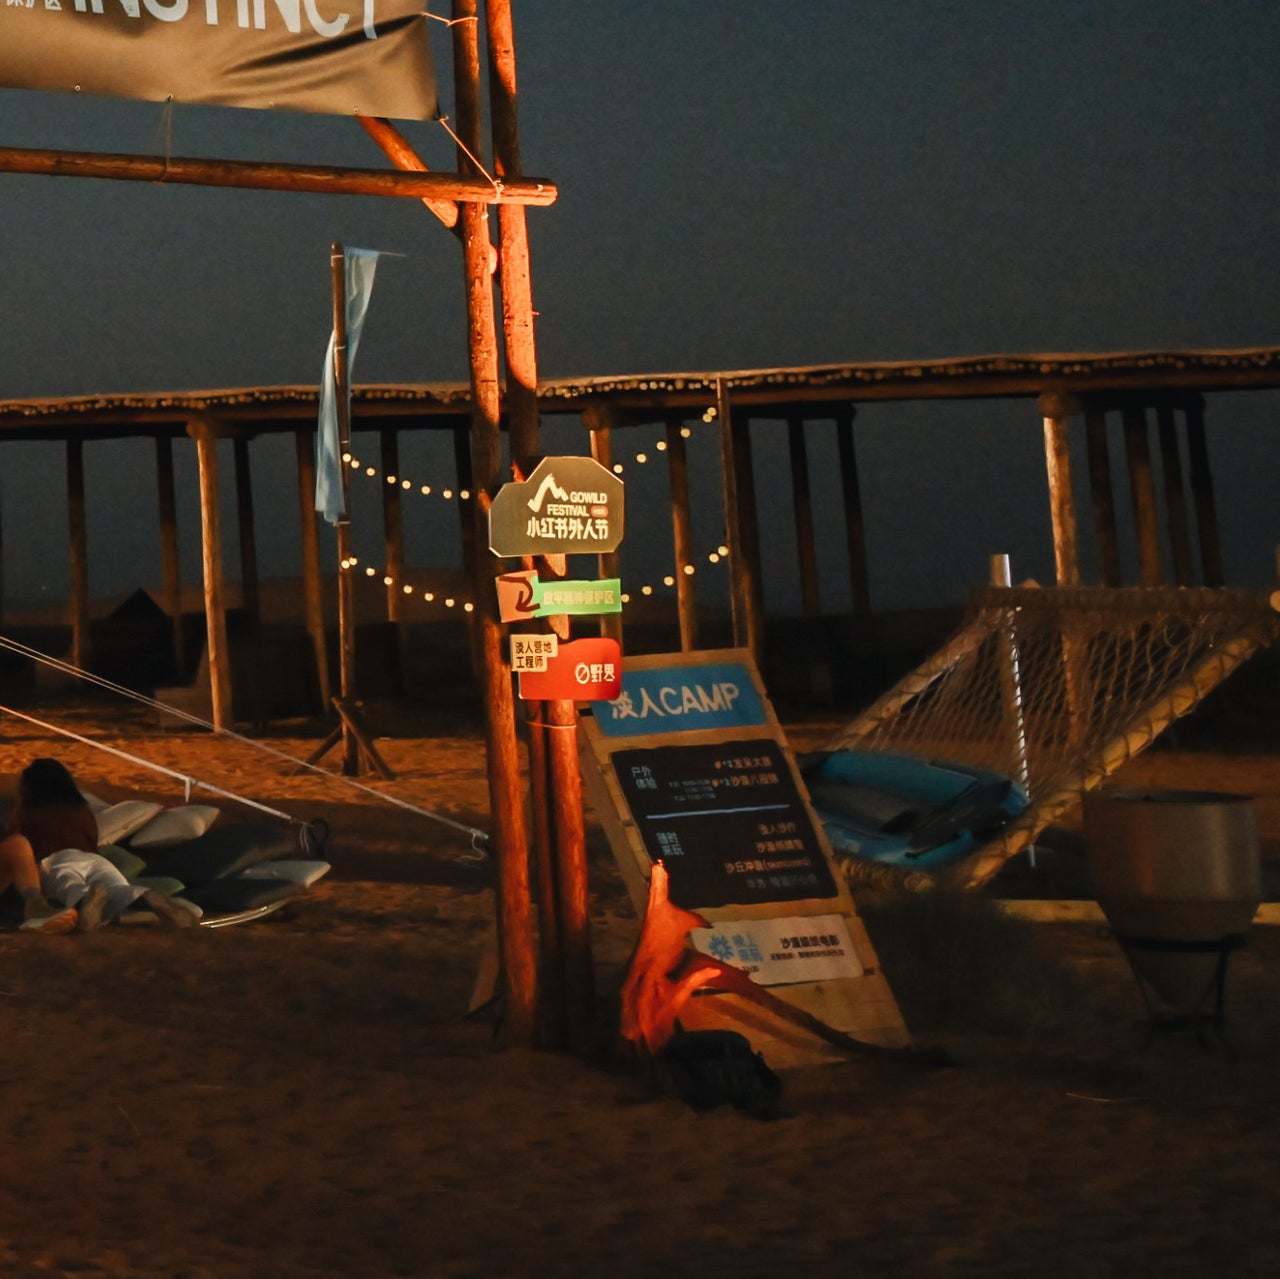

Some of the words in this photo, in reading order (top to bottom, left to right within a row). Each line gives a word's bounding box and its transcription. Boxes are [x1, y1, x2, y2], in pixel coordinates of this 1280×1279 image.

[570, 491, 608, 504] GOWILD
[547, 504, 590, 517] FESTIVAL
[526, 516, 609, 540] 小红书外人节
[515, 640, 552, 654] 淡人营地
[516, 655, 543, 668] 工程师
